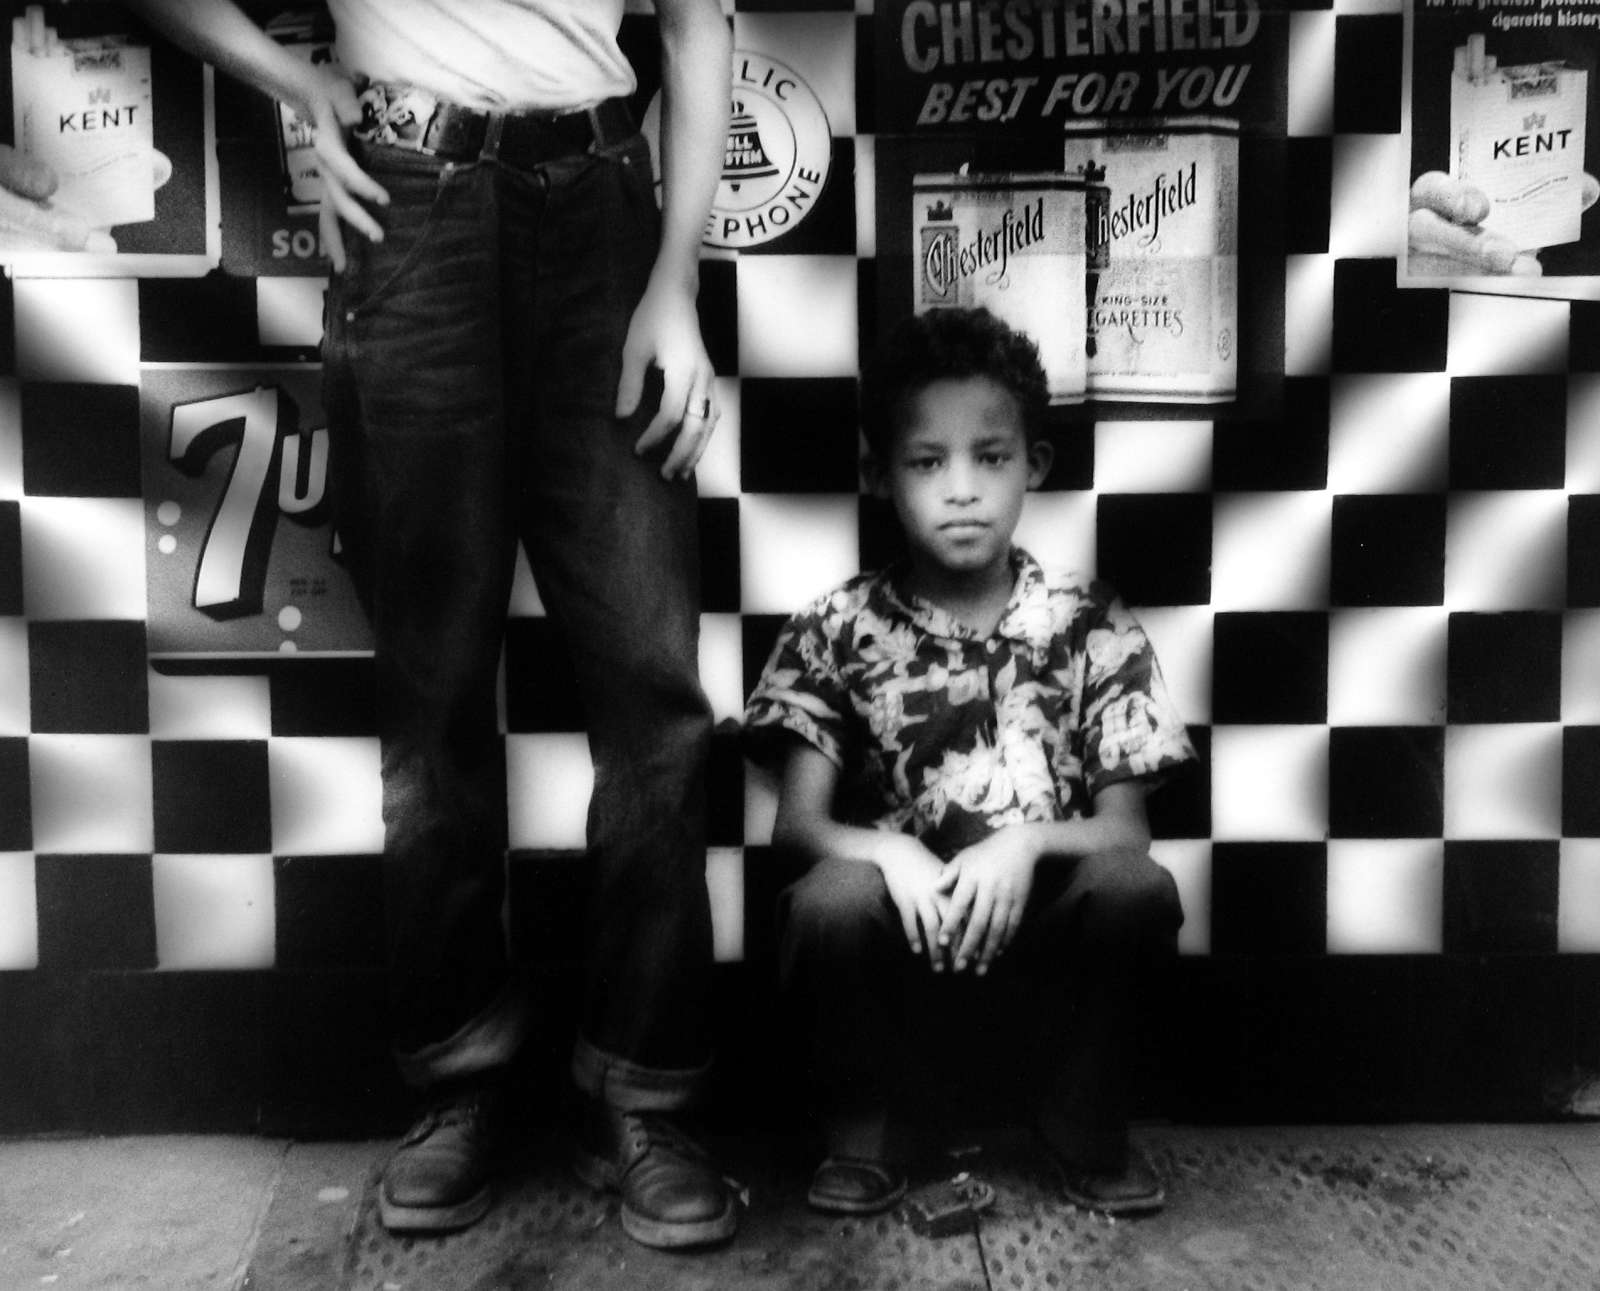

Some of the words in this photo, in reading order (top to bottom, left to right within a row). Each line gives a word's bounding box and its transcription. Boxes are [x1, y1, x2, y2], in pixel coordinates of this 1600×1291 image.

[902, 0, 1260, 73] CHESTERFIELD
[1492, 10, 1552, 31] cigarette
[916, 77, 1039, 126] BEST
[1041, 72, 1140, 117] FOR
[1153, 64, 1252, 111] YOU
[59, 106, 138, 133] KENT
[1493, 129, 1572, 160] KENT
[926, 197, 1046, 297] Chesterfield
